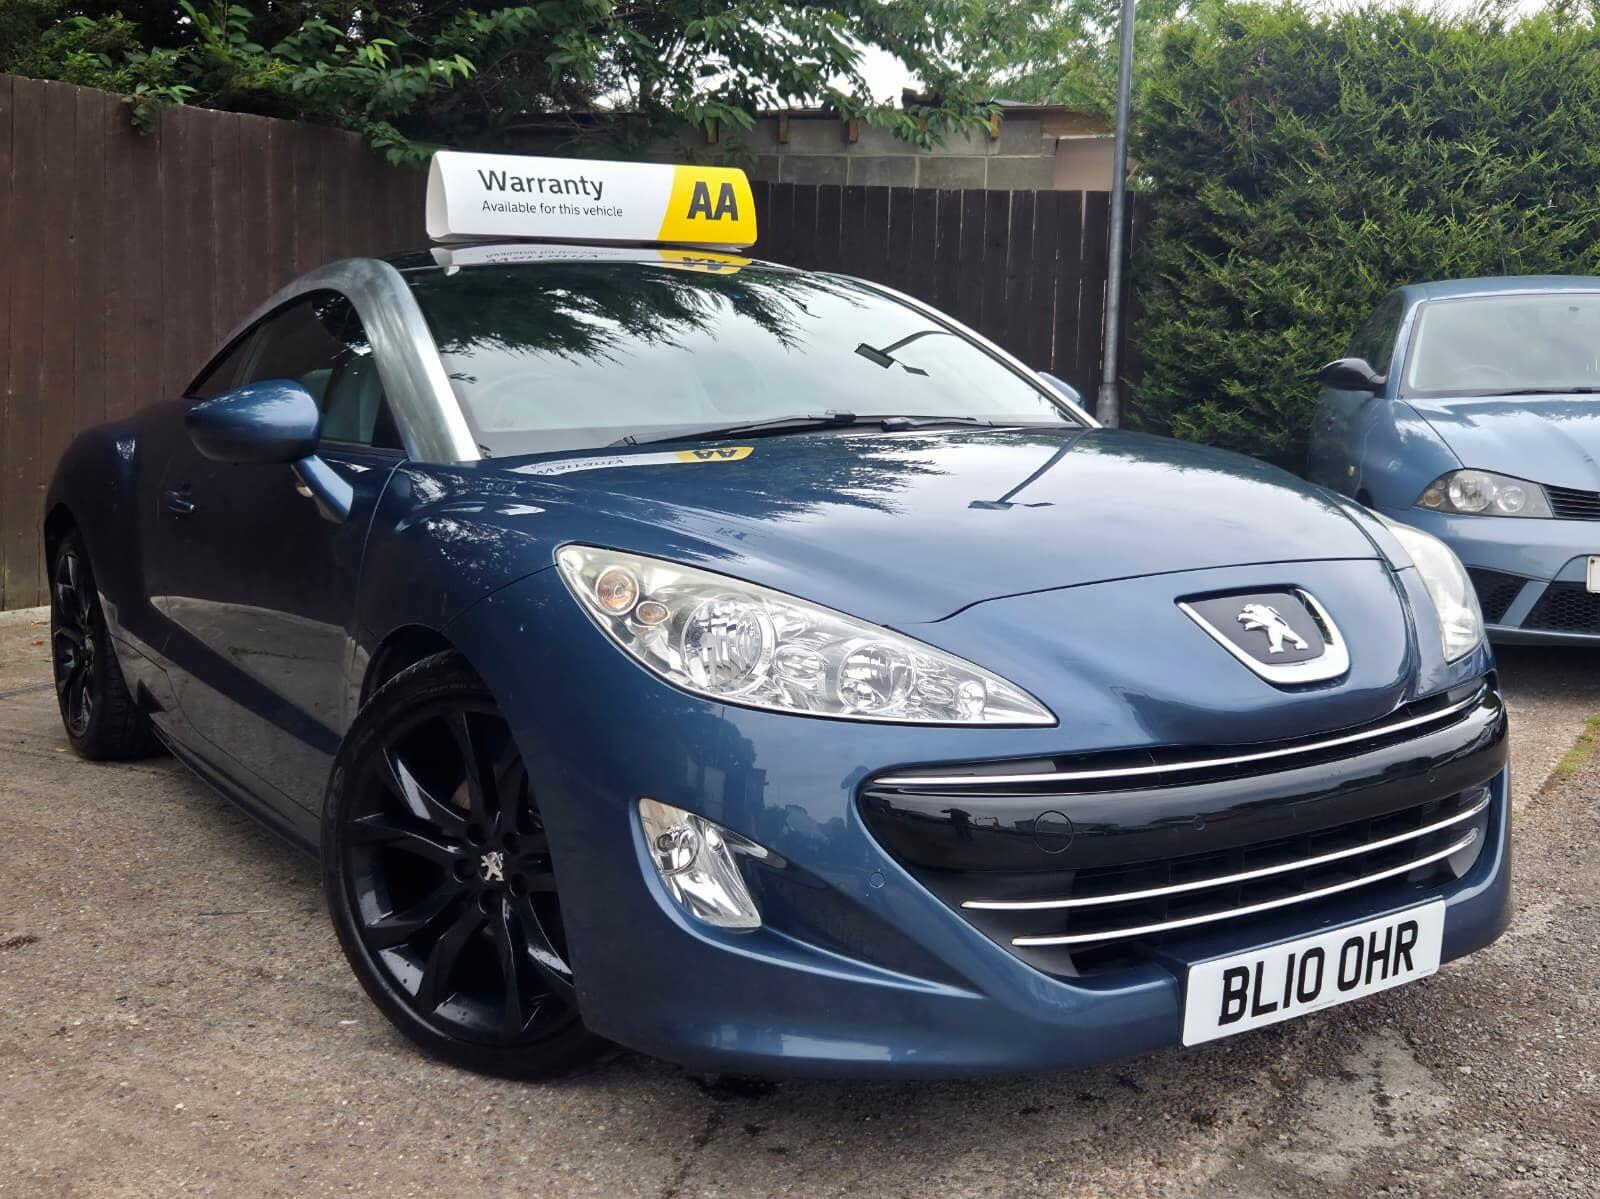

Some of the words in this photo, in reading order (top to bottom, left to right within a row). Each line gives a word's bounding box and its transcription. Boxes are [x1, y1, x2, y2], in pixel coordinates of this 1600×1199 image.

[477, 169, 603, 200] Warranty
[687, 181, 739, 221] AA
[482, 200, 537, 214] Available
[540, 203, 556, 214] for
[559, 204, 580, 215] this
[583, 206, 623, 217] vehicle
[1218, 947, 1325, 1026] BL10
[1337, 920, 1419, 992] OHR
